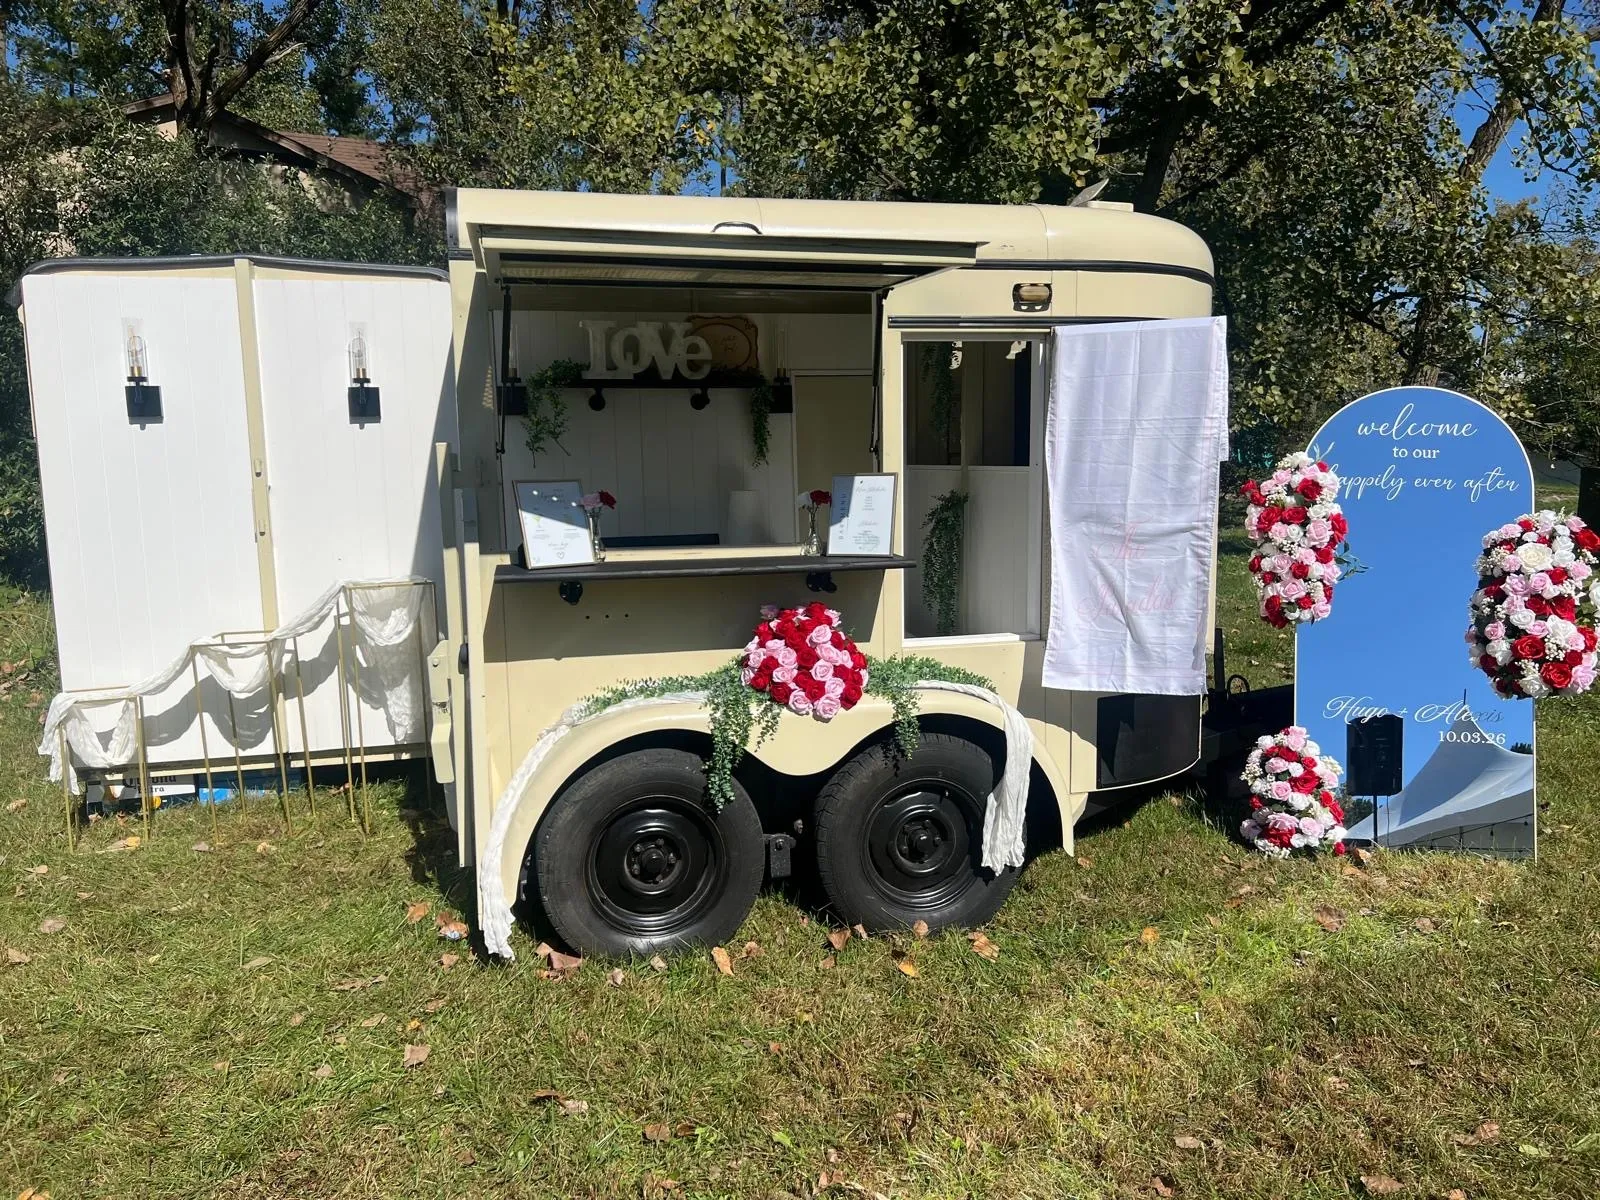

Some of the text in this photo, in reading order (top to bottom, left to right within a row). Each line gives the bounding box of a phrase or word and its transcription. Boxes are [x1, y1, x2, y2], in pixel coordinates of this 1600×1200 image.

[1357, 402, 1478, 440] welcome
[1392, 445, 1440, 459] to our
[1330, 463, 1520, 503] appily ever after
[1322, 696, 1389, 725] Hugo
[1414, 700, 1504, 725] Alexis
[1438, 730, 1506, 745] 10.03.26
